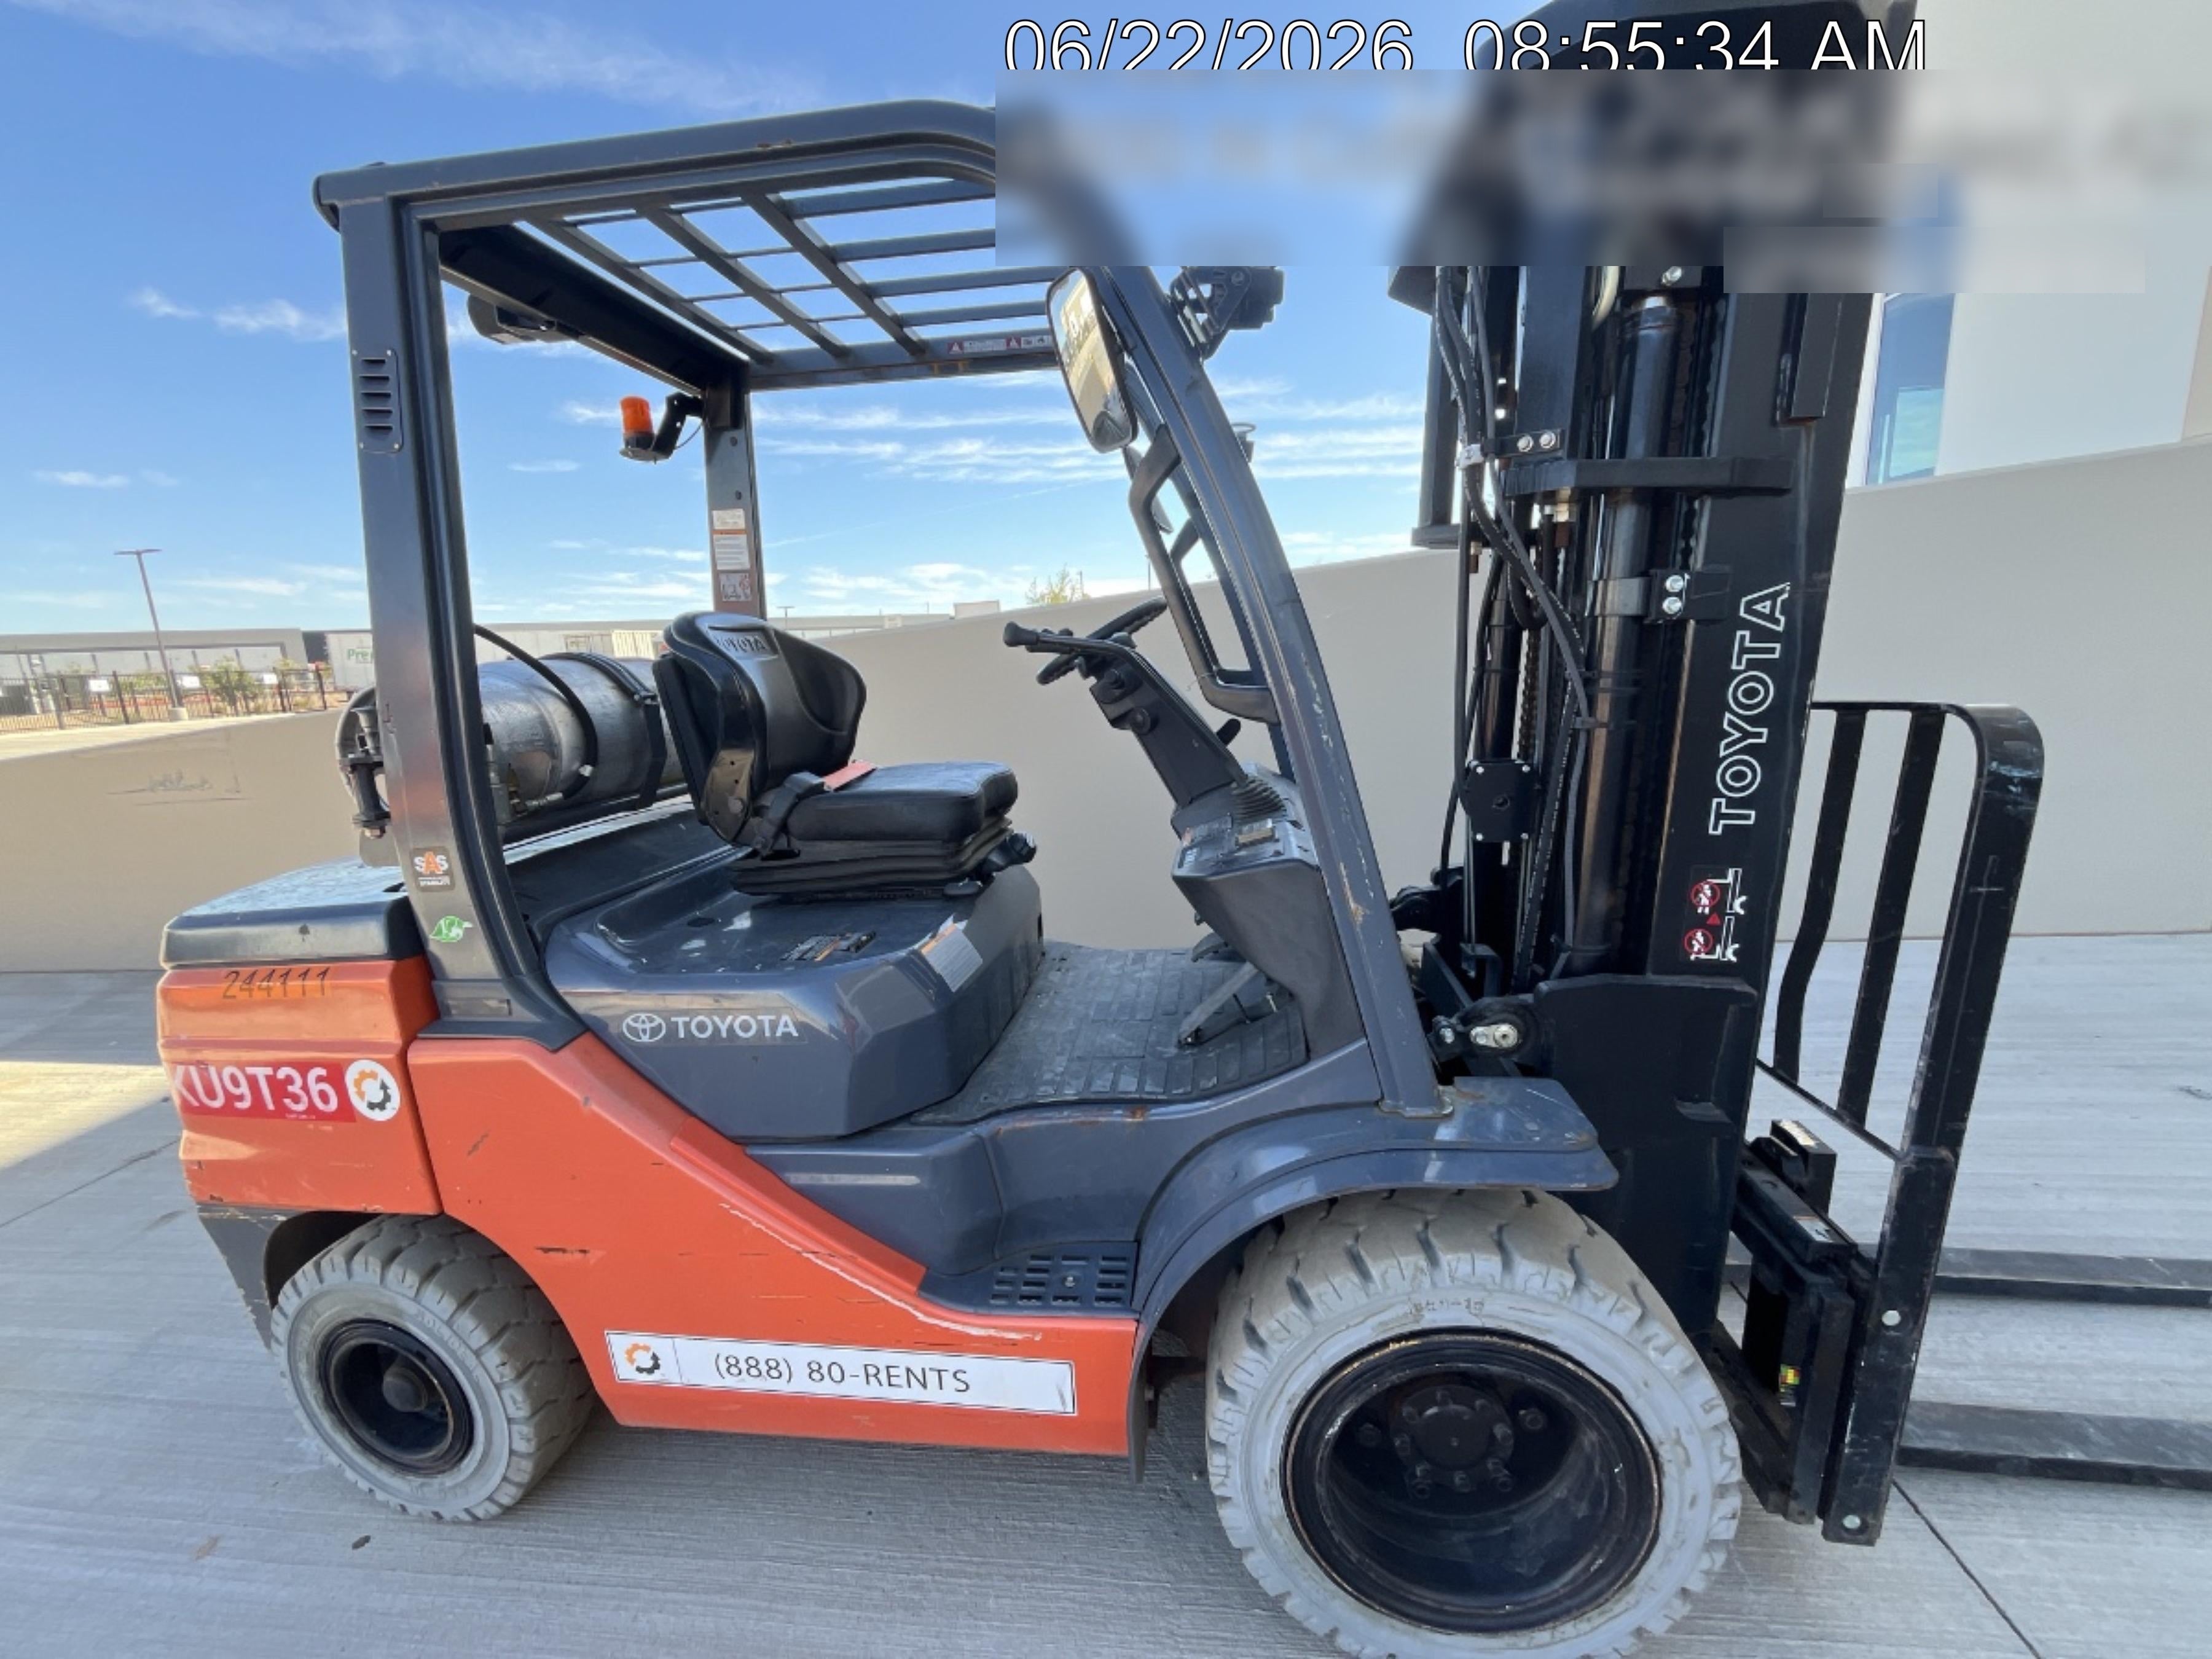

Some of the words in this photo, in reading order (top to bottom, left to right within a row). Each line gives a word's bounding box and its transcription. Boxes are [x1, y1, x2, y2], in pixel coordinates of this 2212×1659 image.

[1709, 581, 1791, 835] TOYOTA
[414, 850, 449, 875] SAS
[222, 967, 330, 1000] 244111
[671, 1013, 799, 1039] TOYOTA
[714, 1354, 793, 1384] (888)
[807, 1359, 971, 1393] 80-RENTS
